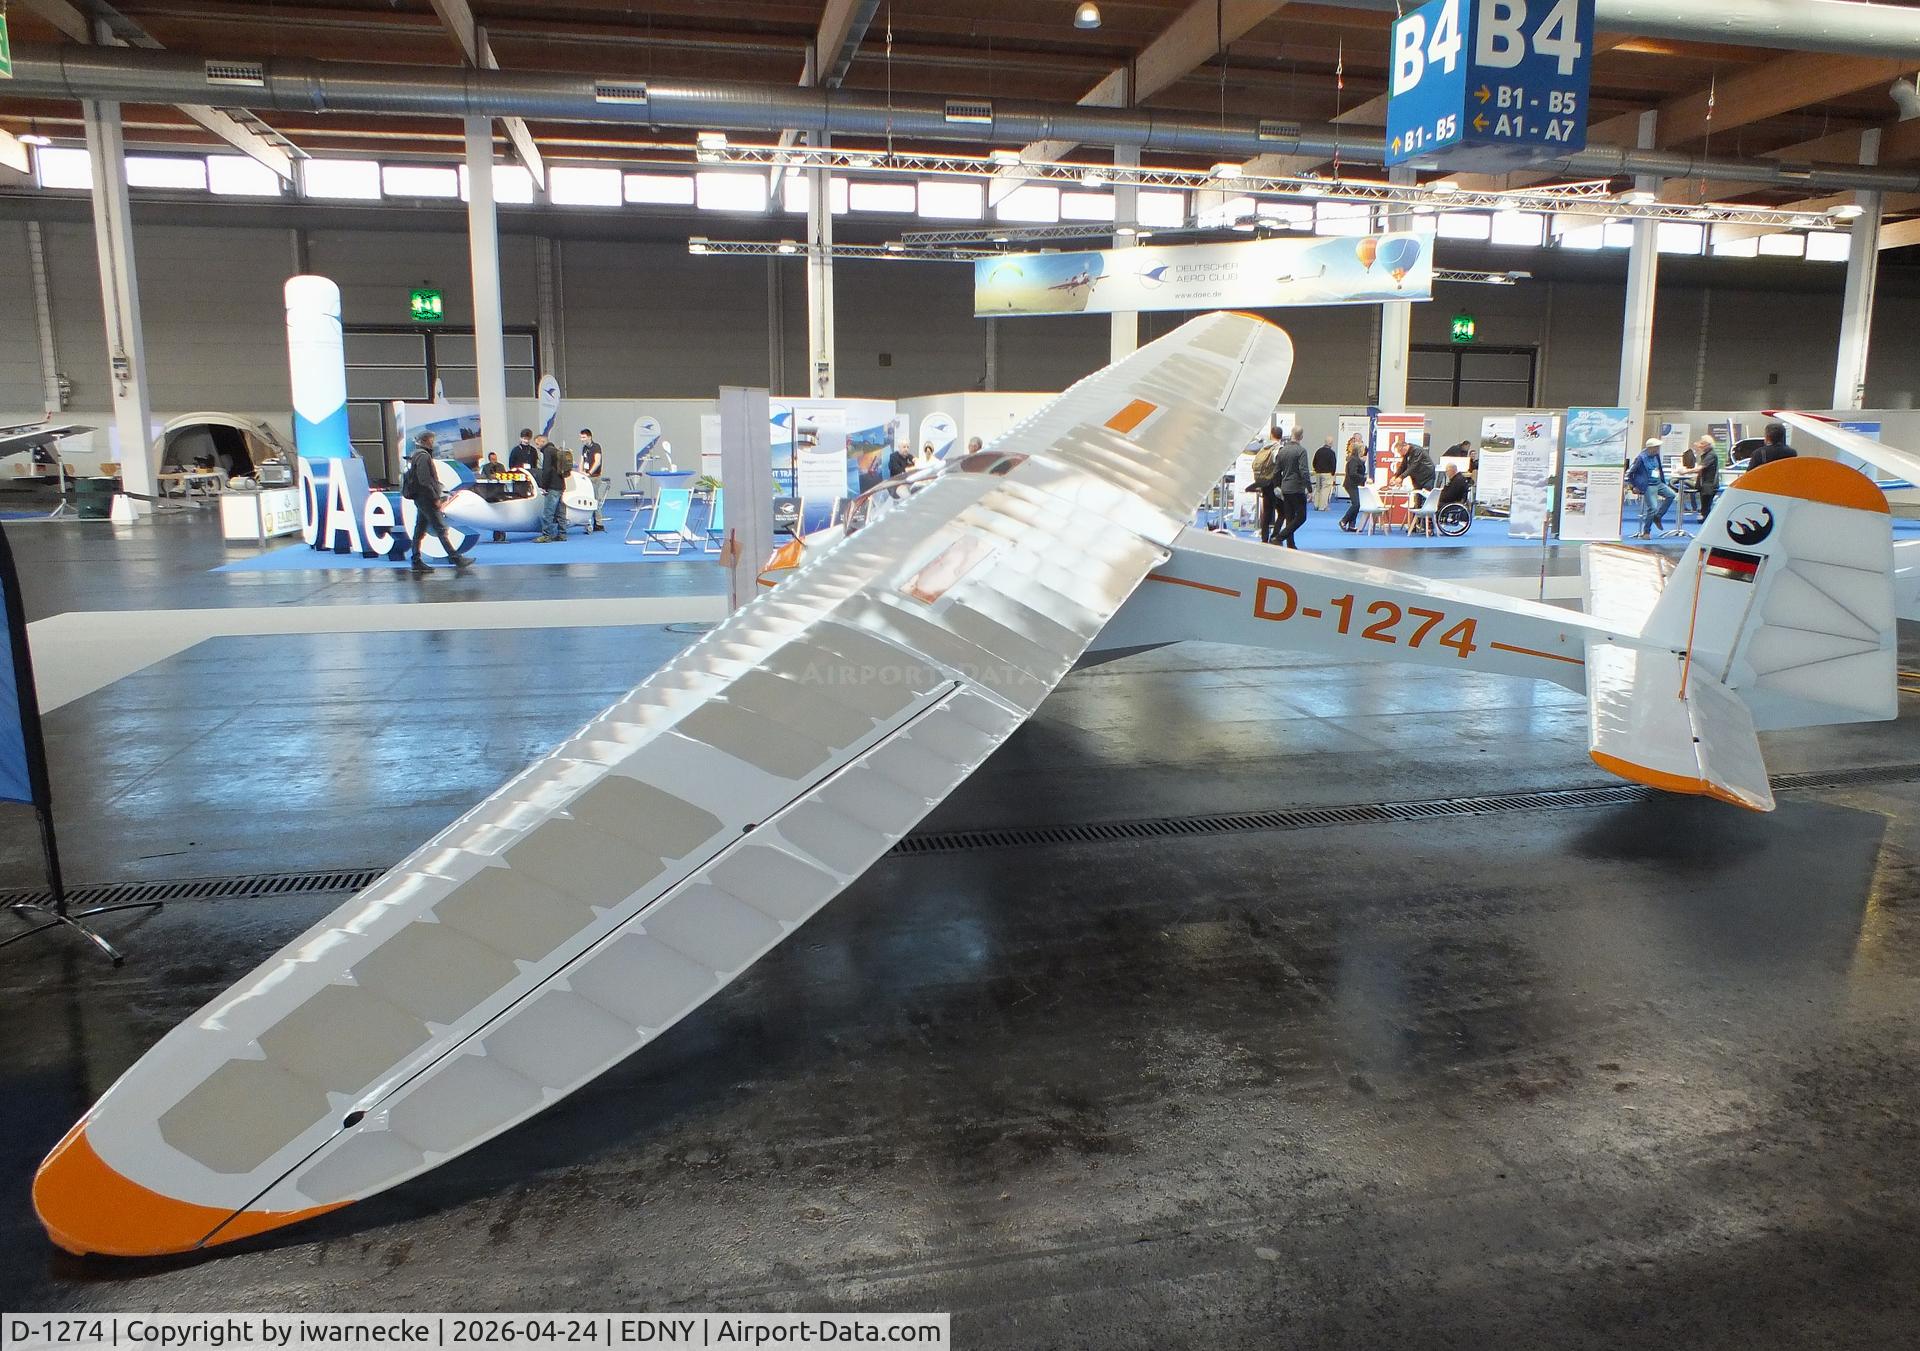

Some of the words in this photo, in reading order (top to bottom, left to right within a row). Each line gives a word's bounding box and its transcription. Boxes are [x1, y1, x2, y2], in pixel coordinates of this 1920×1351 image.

[1393, 0, 1461, 97] B4
[1475, 0, 1581, 76] B4
[1496, 86, 1523, 110] B1
[1548, 91, 1576, 115] B5
[1404, 126, 1423, 152] B1
[1436, 114, 1456, 141] B5
[1494, 114, 1523, 137] A1
[1545, 119, 1575, 142] A7
[1176, 262, 1238, 273] DEUTSCHER
[1176, 273, 1206, 283] AERO
[1253, 576, 1478, 659] D-1274
